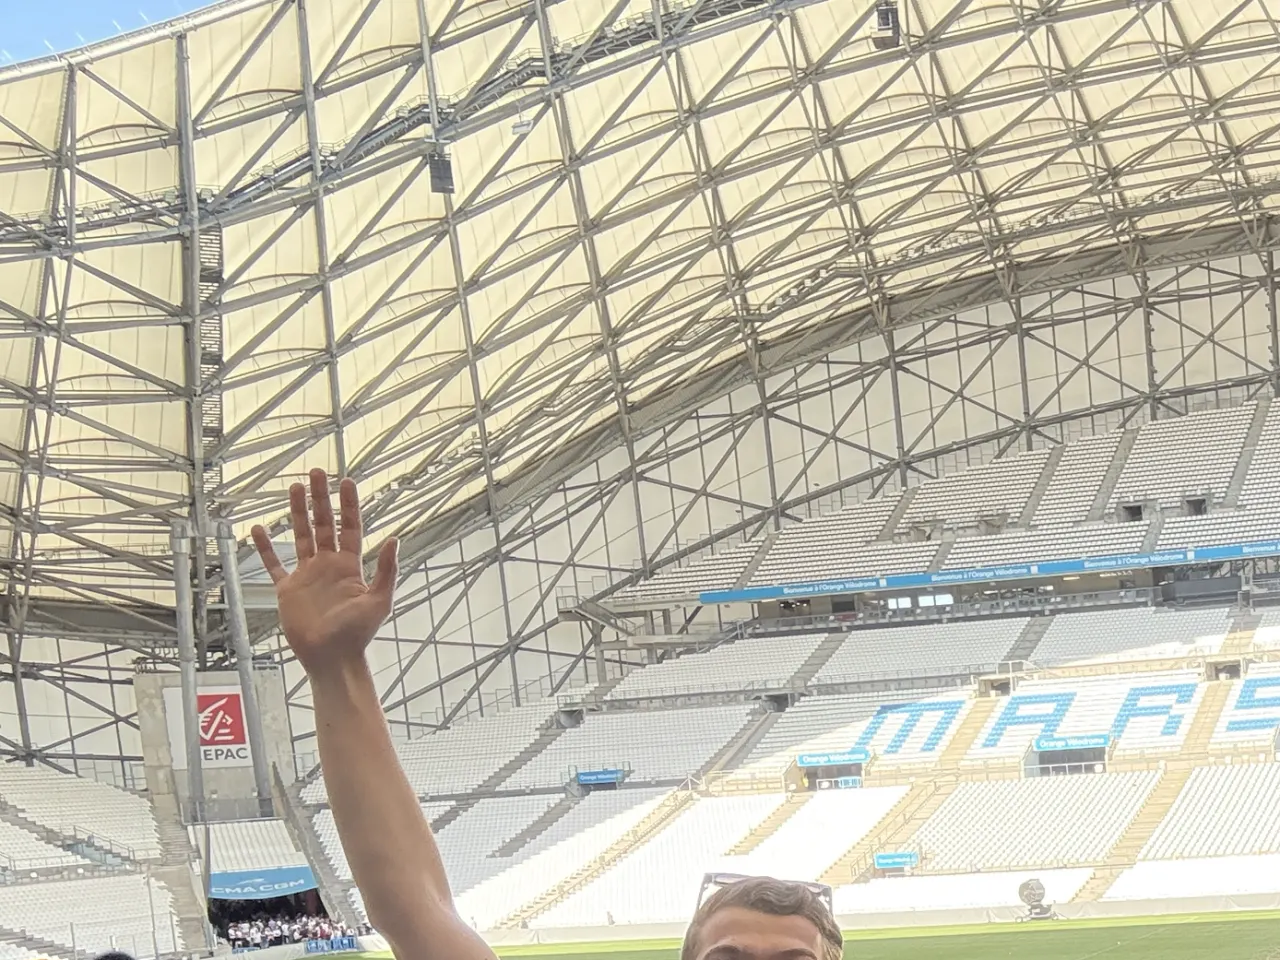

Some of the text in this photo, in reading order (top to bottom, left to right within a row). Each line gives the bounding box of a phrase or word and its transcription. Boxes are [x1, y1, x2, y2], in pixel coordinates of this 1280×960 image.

[1040, 740, 1066, 748] Orange
[203, 747, 248, 761] EPAC
[802, 755, 829, 763] Orange
[212, 879, 304, 894] CMA CGM
